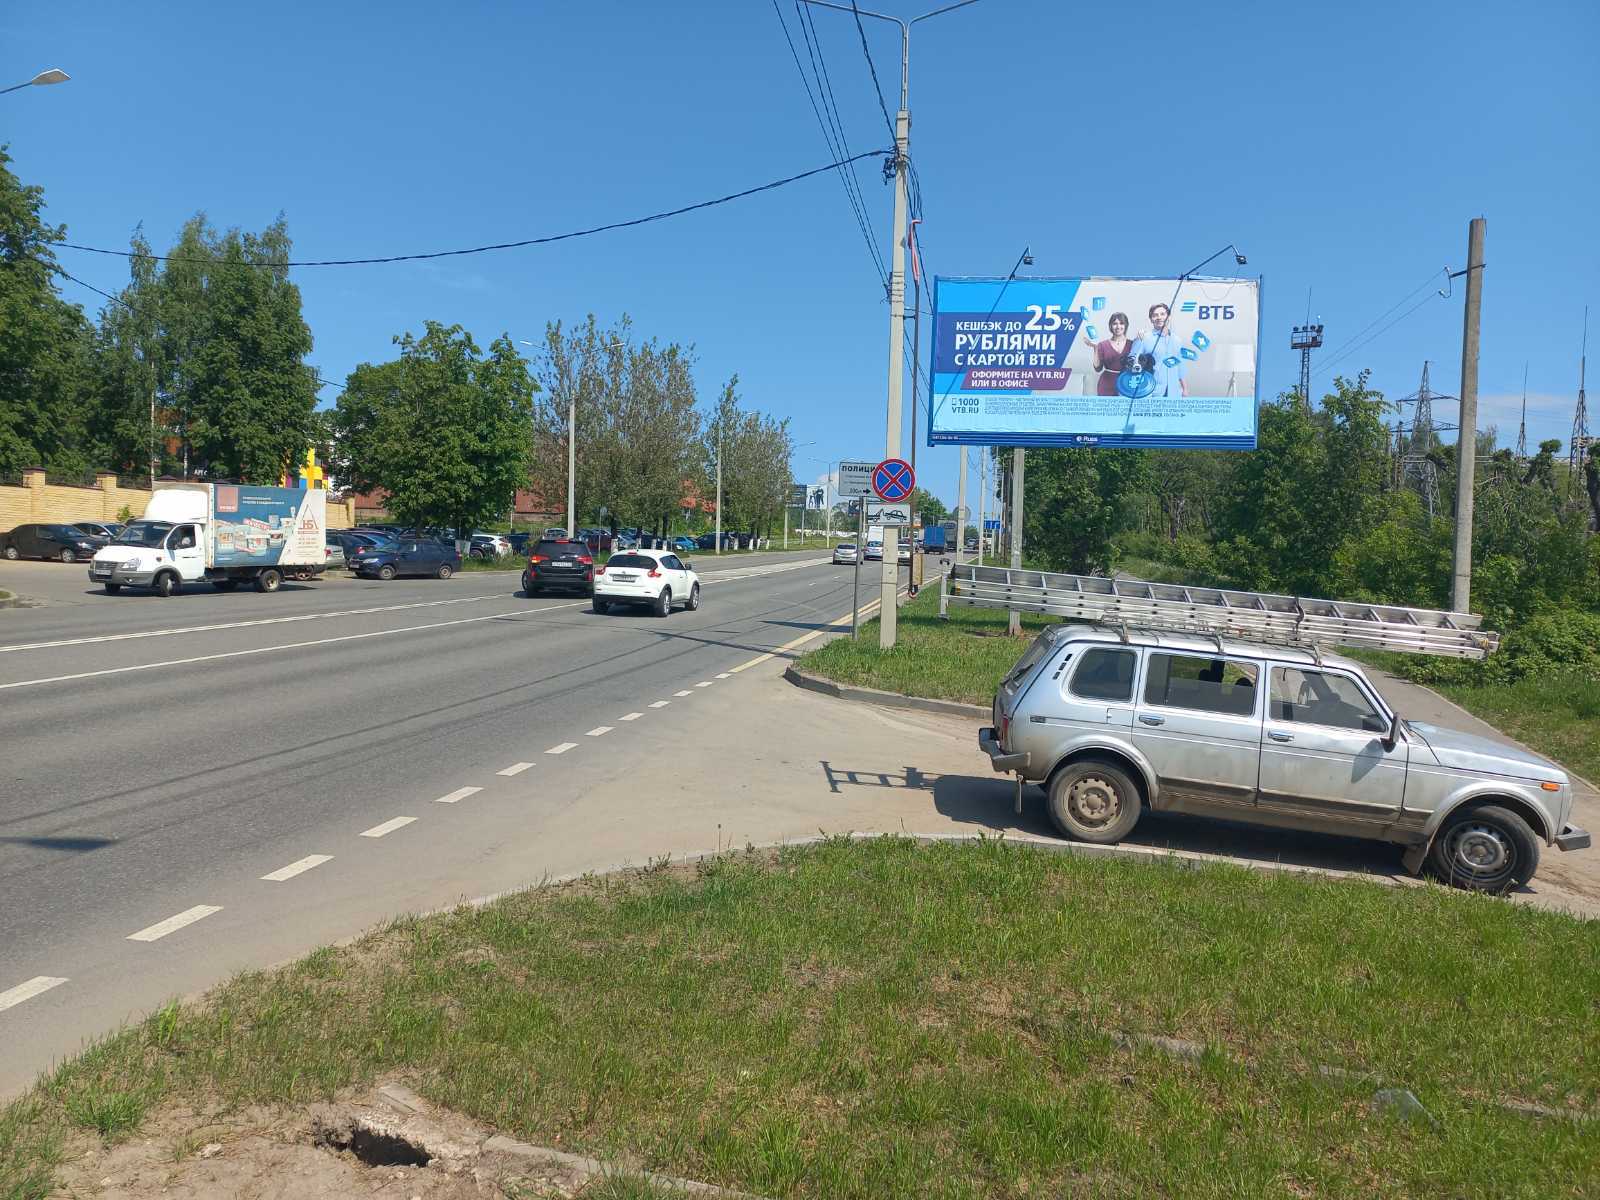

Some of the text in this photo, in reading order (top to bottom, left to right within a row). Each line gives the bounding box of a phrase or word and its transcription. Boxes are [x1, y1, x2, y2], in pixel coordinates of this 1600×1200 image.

[956, 304, 1075, 332] КЕШБЭК ДО 25%
[1199, 305, 1235, 320] ВТБ
[955, 333, 1056, 351] РУБЛЯМИ
[954, 351, 1055, 366] С КАРТОЙ ВТБ
[971, 370, 1065, 379] ОФОРМИТЕ НА VTB.RU
[971, 379, 1029, 388] ИЛИ В ОФИСЕ
[959, 398, 979, 406] 1000
[841, 465, 876, 473] ПОЛИЦИ
